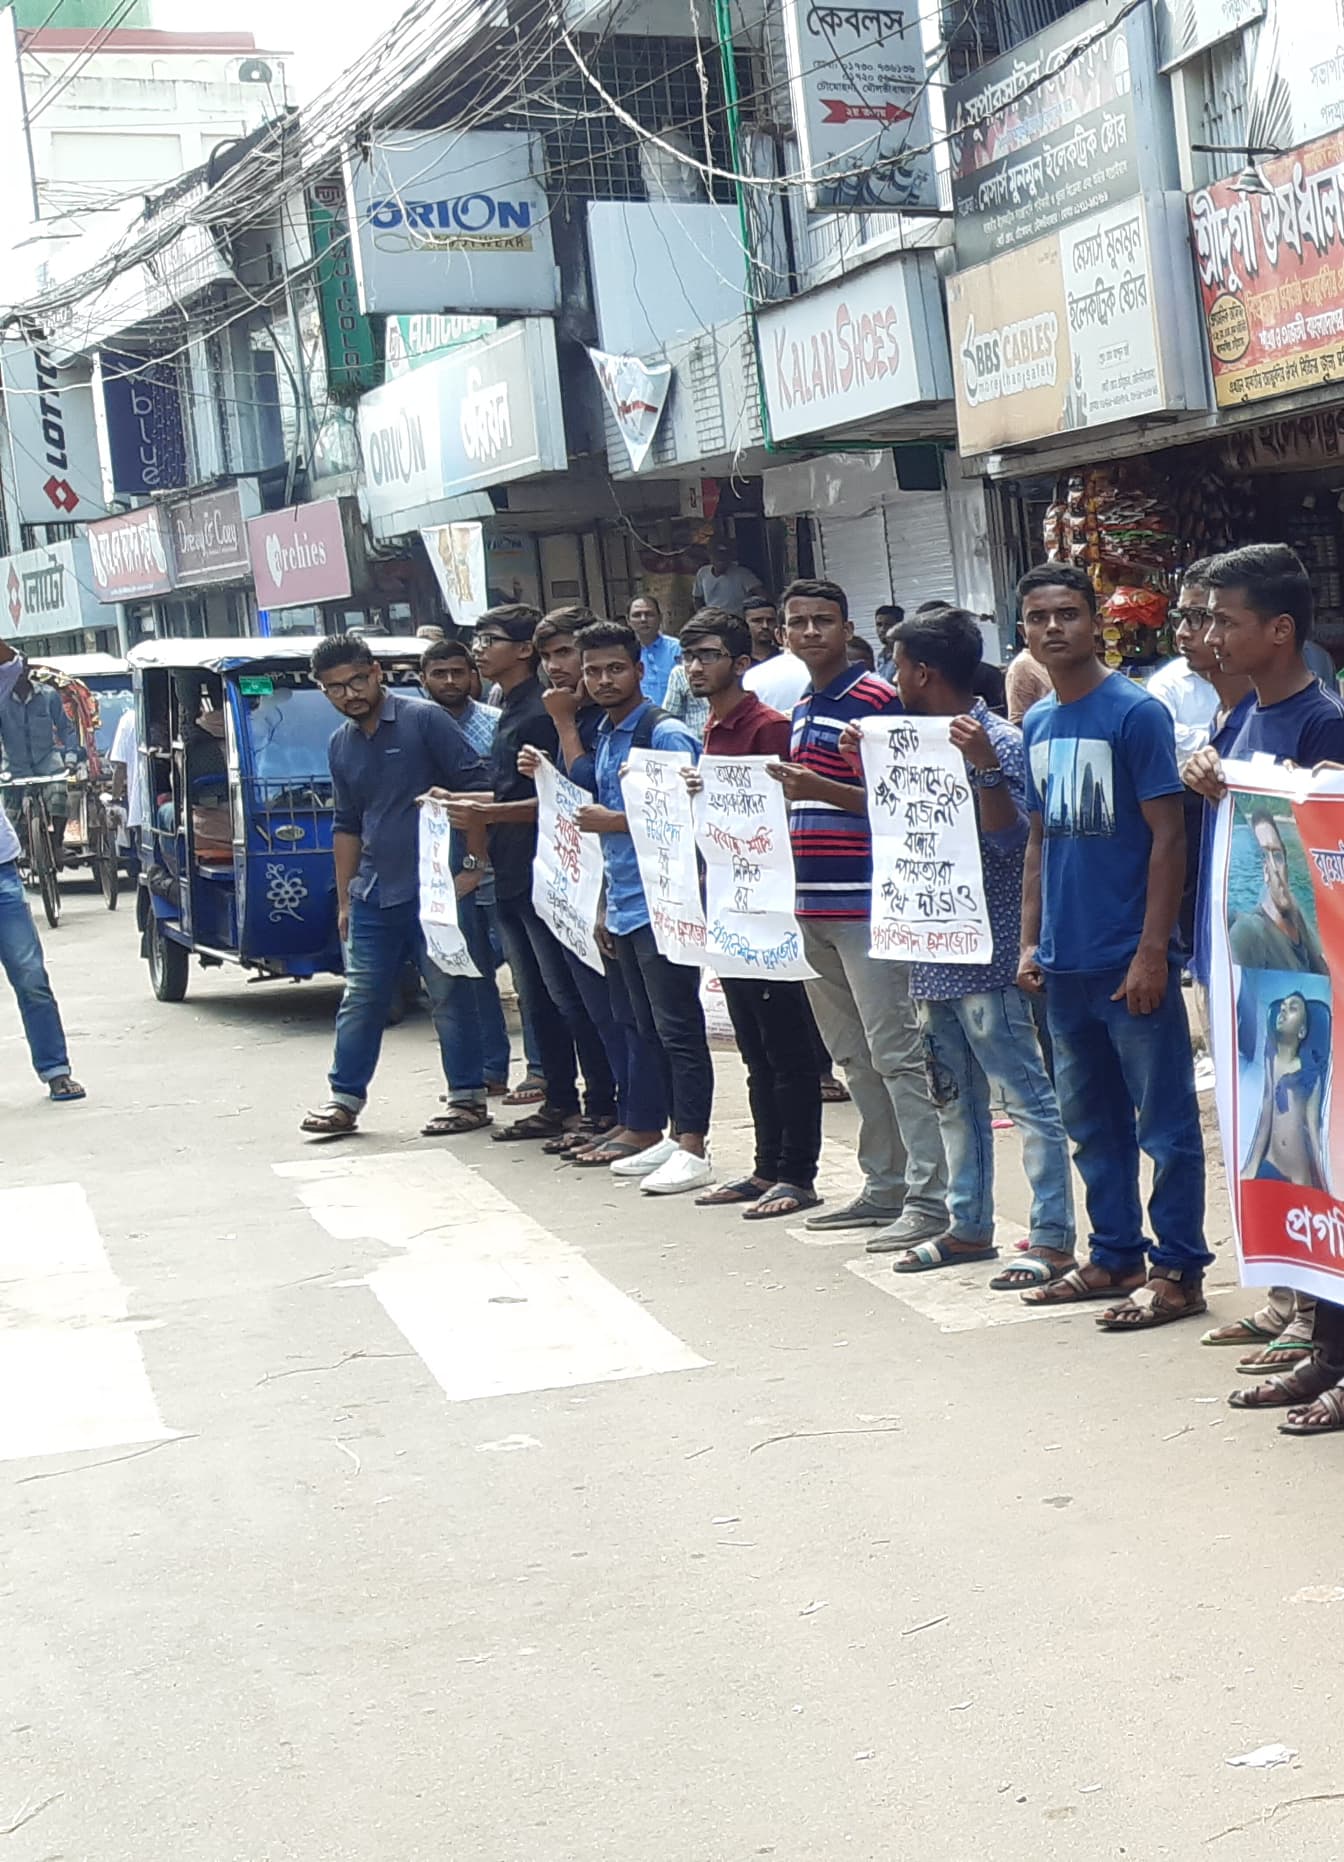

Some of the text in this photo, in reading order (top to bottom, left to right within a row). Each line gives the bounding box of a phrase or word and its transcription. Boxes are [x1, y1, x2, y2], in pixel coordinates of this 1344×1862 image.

[367, 194, 531, 231] ORION
[1104, 217, 1142, 269] মুনমুন
[774, 303, 899, 411] KALAM SHOES
[976, 341, 999, 377] BBS
[1003, 325, 1052, 367] CABLES
[369, 408, 427, 487] ORION
